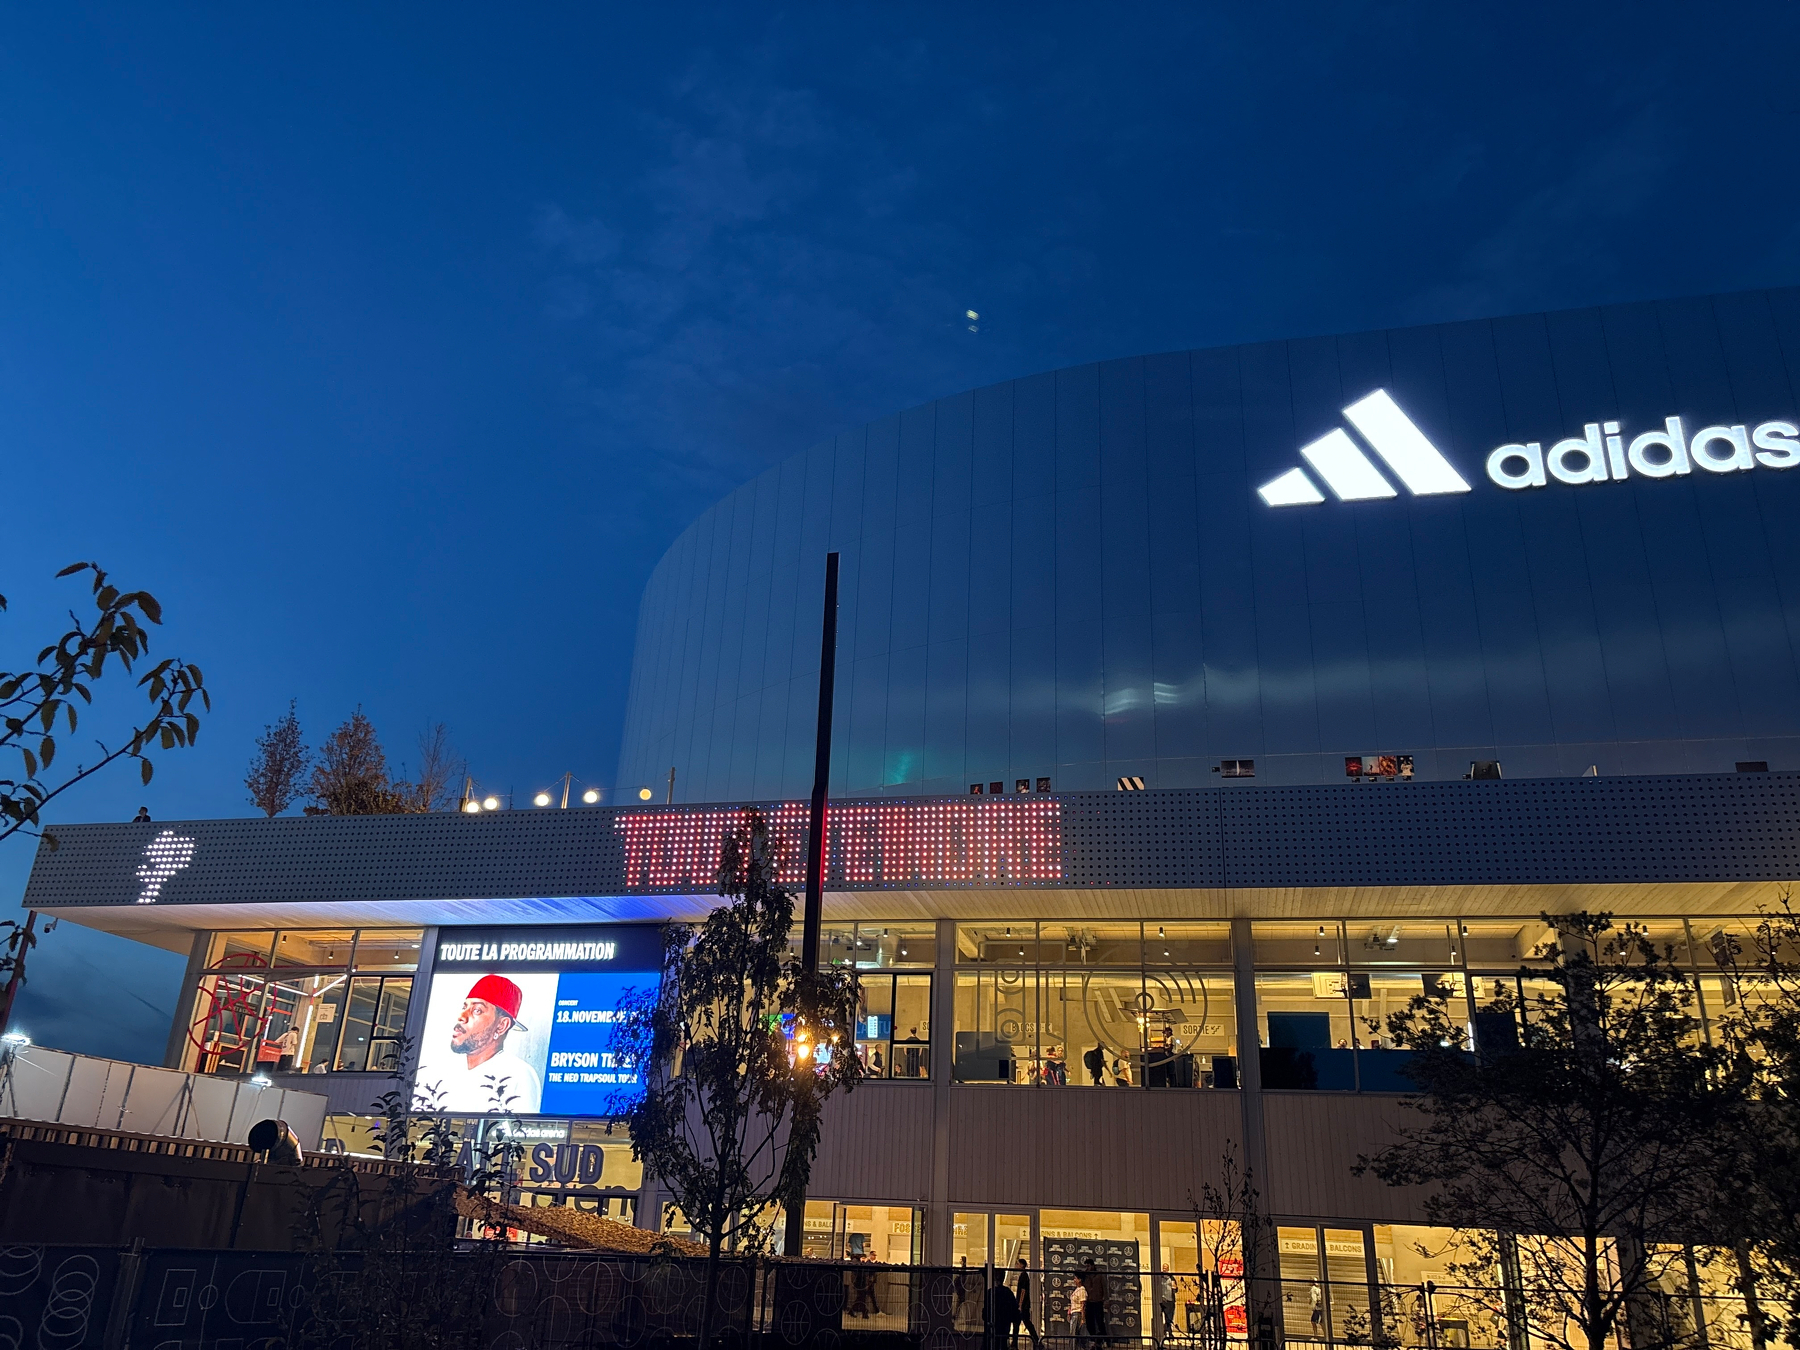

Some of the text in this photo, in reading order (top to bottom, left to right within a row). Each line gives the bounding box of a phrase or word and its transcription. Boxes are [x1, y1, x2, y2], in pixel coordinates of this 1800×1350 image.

[1487, 416, 1800, 489] adidas
[440, 942, 615, 961] TOUTE LA PROGRAMMATION
[551, 1053, 598, 1068] BRYSON
[548, 1072, 563, 1082] THE
[563, 1073, 579, 1083] NEO
[580, 1073, 616, 1083] TRAPSOUL
[529, 1143, 604, 1184] SUD
[1292, 1242, 1361, 1253] GRADIN BALCONS
